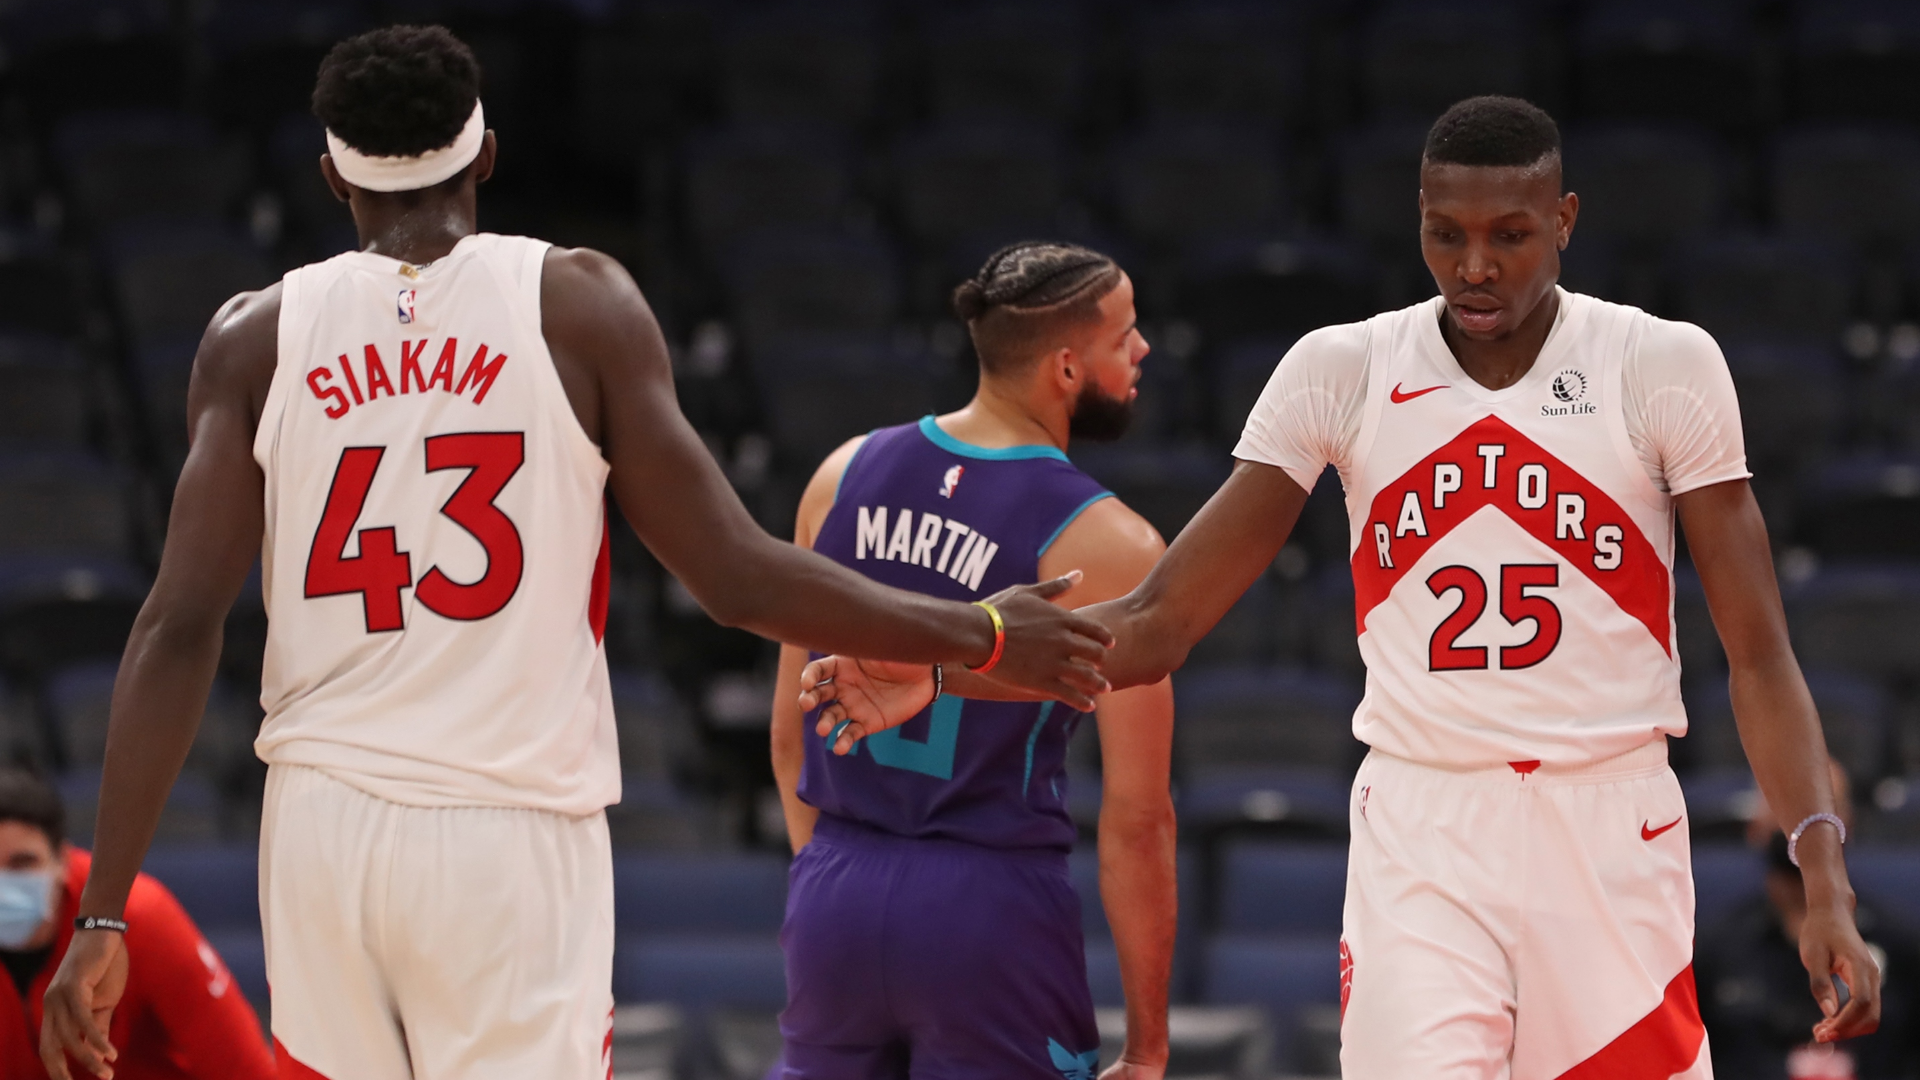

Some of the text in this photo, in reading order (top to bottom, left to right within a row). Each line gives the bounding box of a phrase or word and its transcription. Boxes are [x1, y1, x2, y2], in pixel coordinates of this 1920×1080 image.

[306, 337, 508, 420] SIAKAM
[1541, 402, 1597, 417] Sun Life
[304, 431, 525, 633] 43
[856, 506, 999, 592] MARTIN
[1374, 444, 1624, 571] RAPTORS
[1425, 563, 1563, 672] 25
